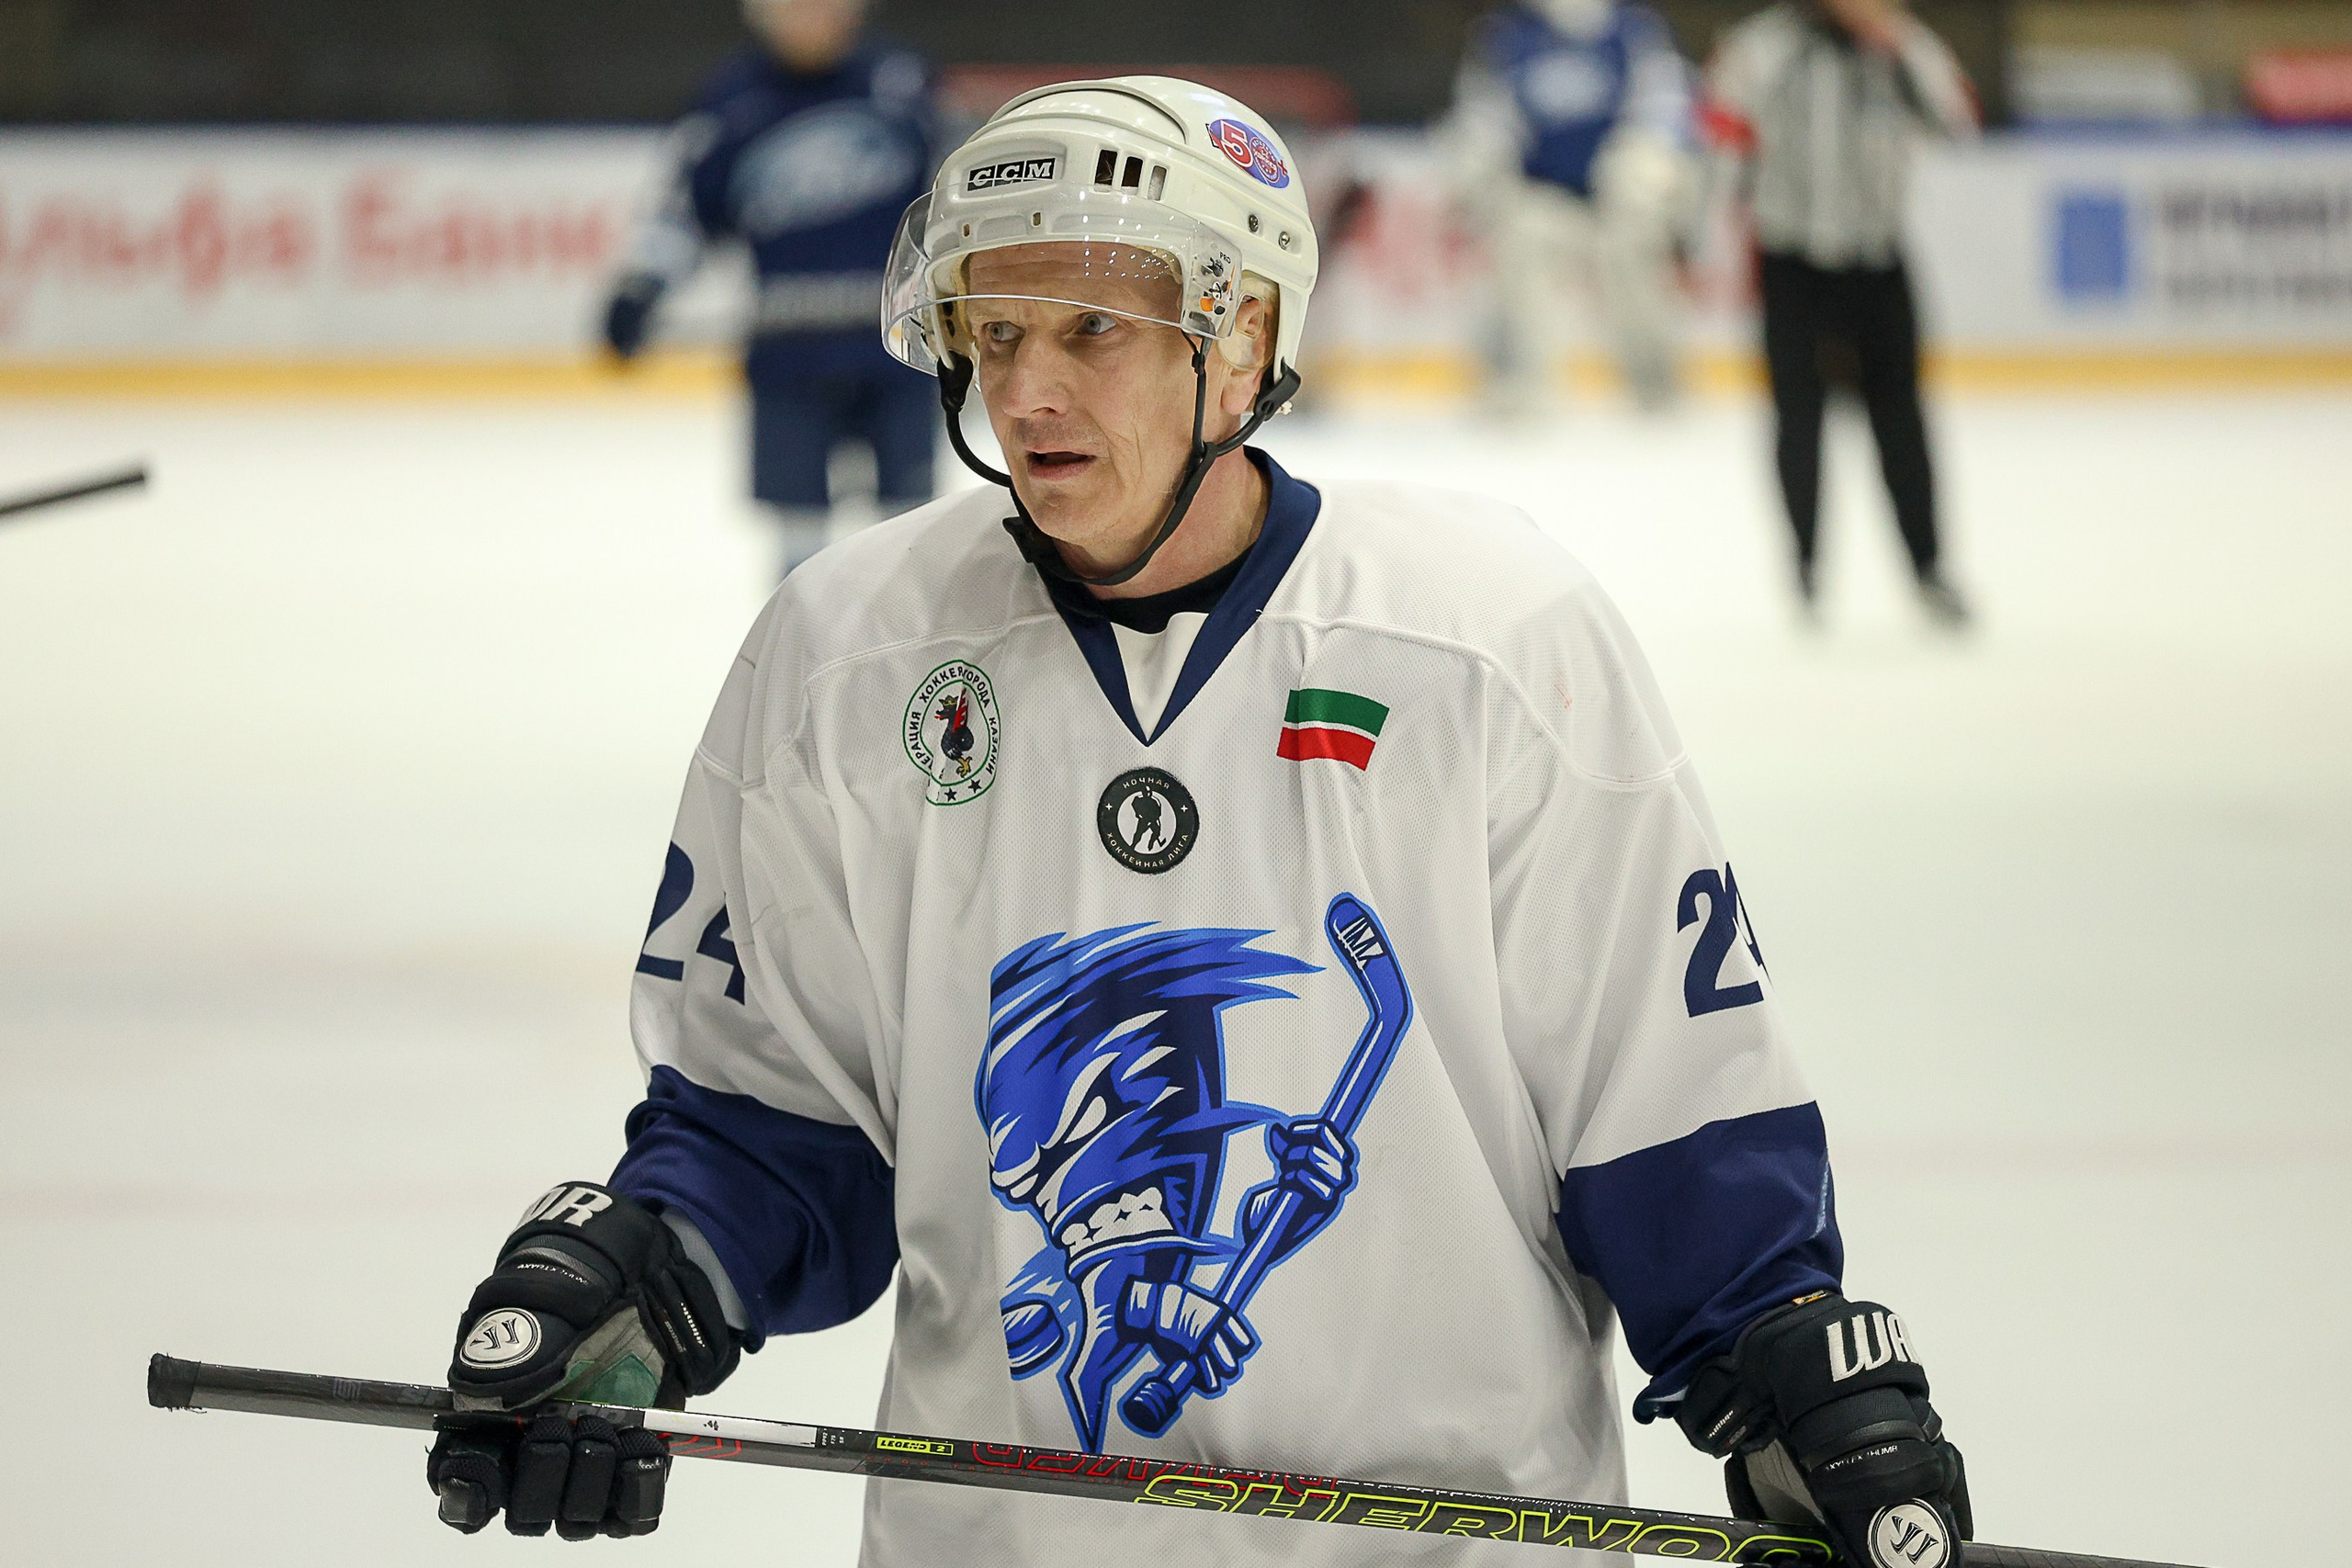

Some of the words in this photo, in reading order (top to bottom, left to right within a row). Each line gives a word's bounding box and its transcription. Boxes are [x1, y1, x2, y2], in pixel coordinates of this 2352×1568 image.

[970, 161, 1054, 187] CCM
[919, 666, 963, 704] ХОККЕЯ
[985, 716, 999, 775] КАЗАНИ
[1123, 777, 1170, 789] НОЧНАЯ
[1107, 832, 1165, 868] ХОККЕЙНАЯ
[1168, 834, 1189, 861] ЛИГА
[879, 1439, 927, 1450] LEGEND
[1133, 1473, 1838, 1563] SHERWOO
